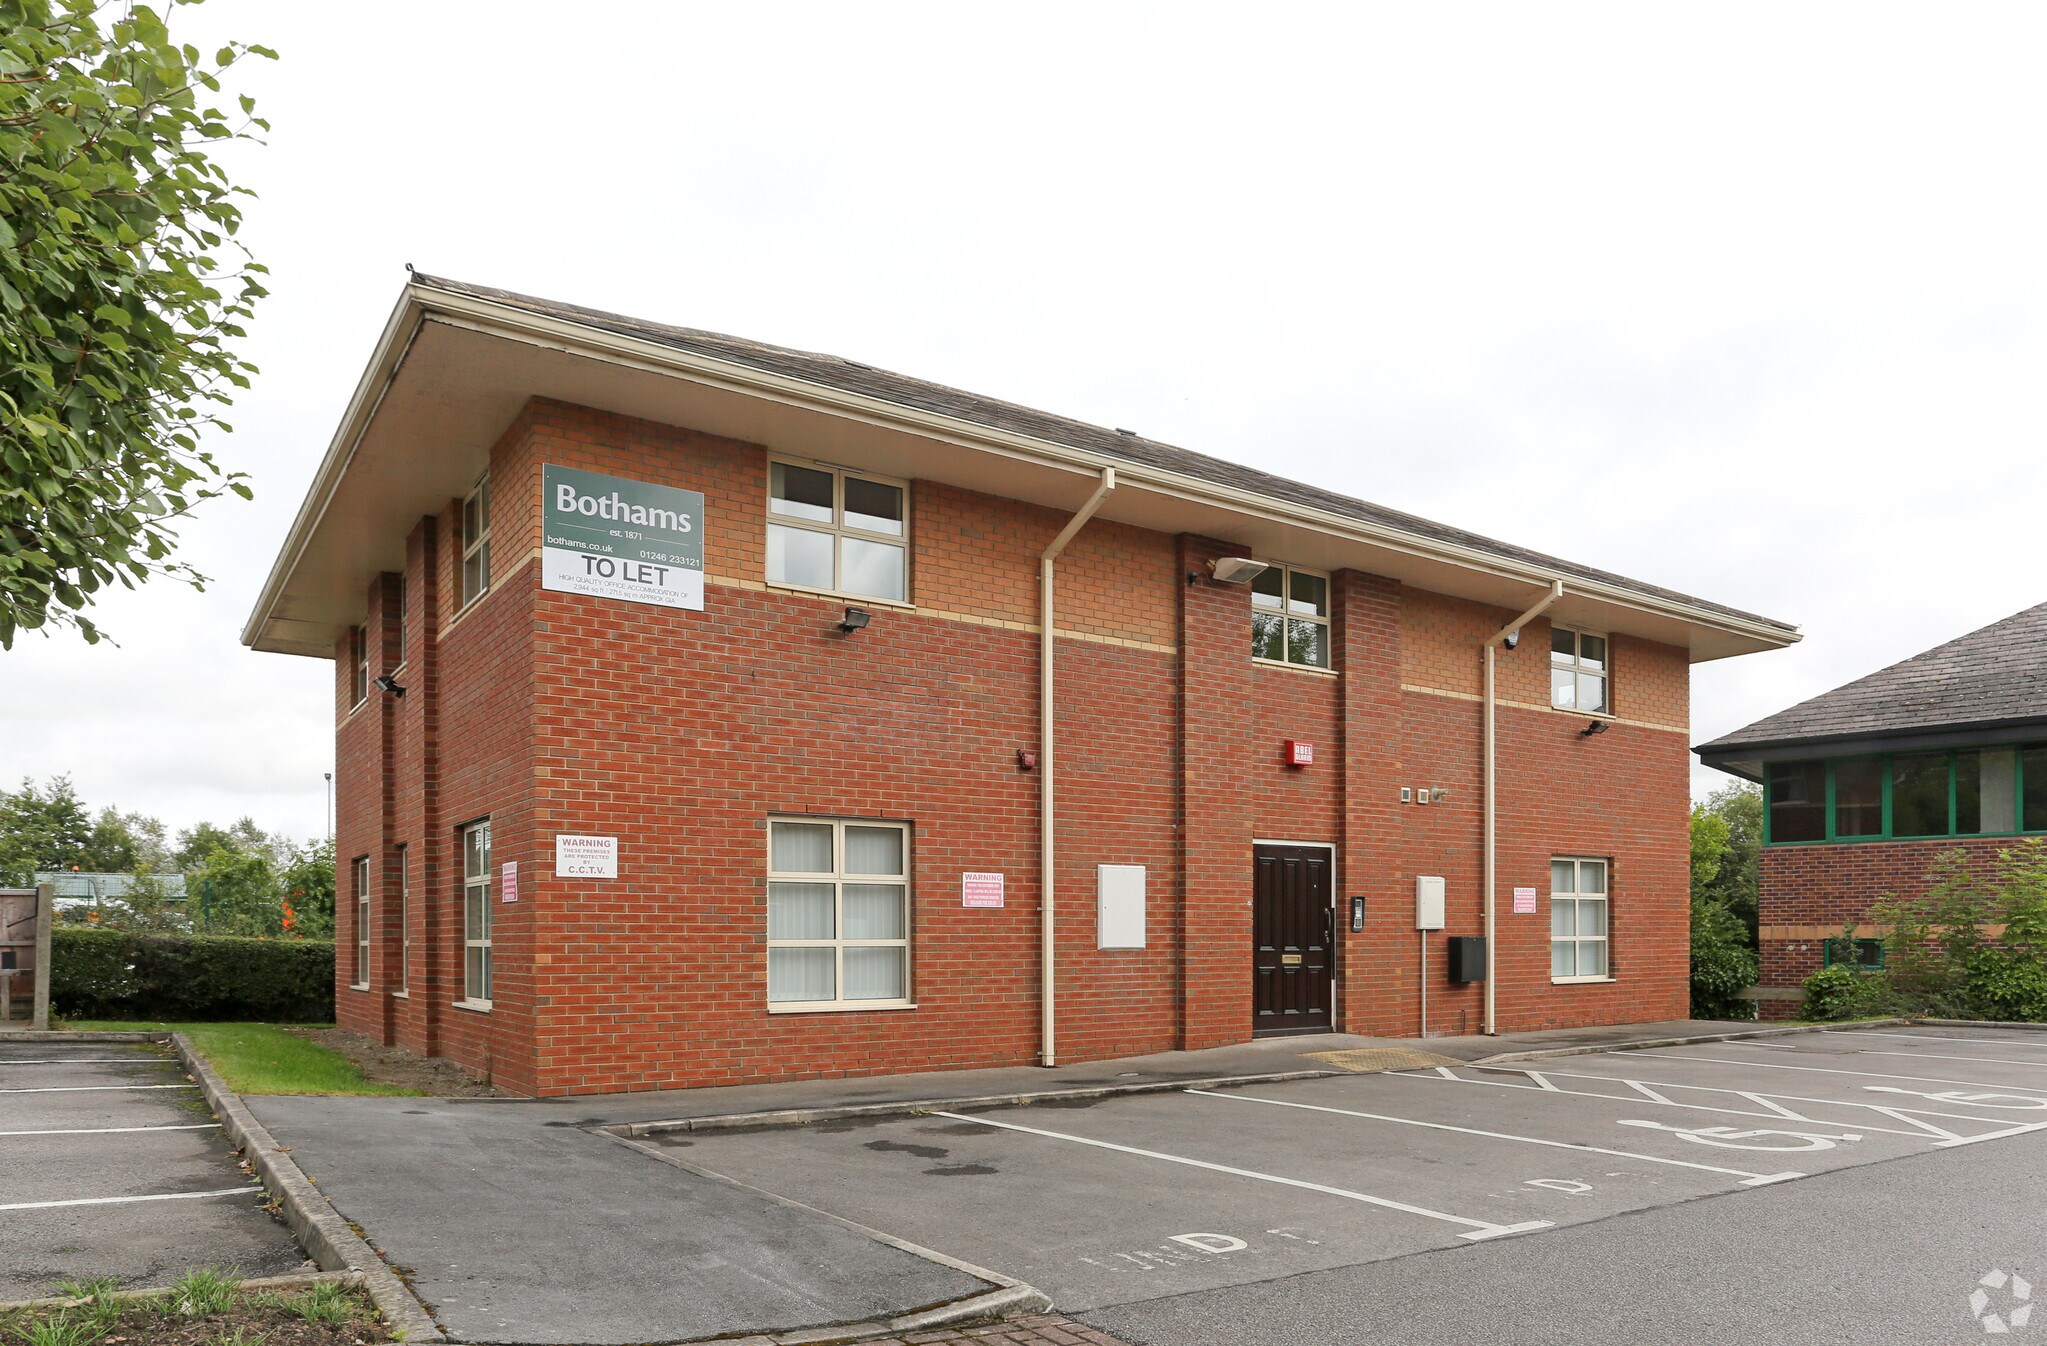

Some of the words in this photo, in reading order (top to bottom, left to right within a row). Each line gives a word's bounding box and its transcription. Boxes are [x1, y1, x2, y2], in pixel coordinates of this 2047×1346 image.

[557, 484, 692, 533] Bothams
[547, 535, 614, 553] bothams.co.uk
[609, 529, 623, 538] est.
[624, 530, 642, 541] 1871
[640, 549, 667, 561] 01246
[669, 555, 700, 567] 233121
[581, 555, 616, 578] TO
[623, 562, 669, 586] LET
[573, 583, 590, 592] 2,944
[623, 591, 631, 599] sq
[639, 593, 664, 602] APPROX
[575, 576, 602, 586] QUALITY
[604, 581, 626, 590] OFFICE
[627, 584, 679, 597] ACCOMMODATION
[1295, 745, 1312, 754] ABEL
[562, 838, 611, 848] WARNING
[568, 865, 606, 875] C.C.T.V.
[965, 873, 1002, 882] WARNING
